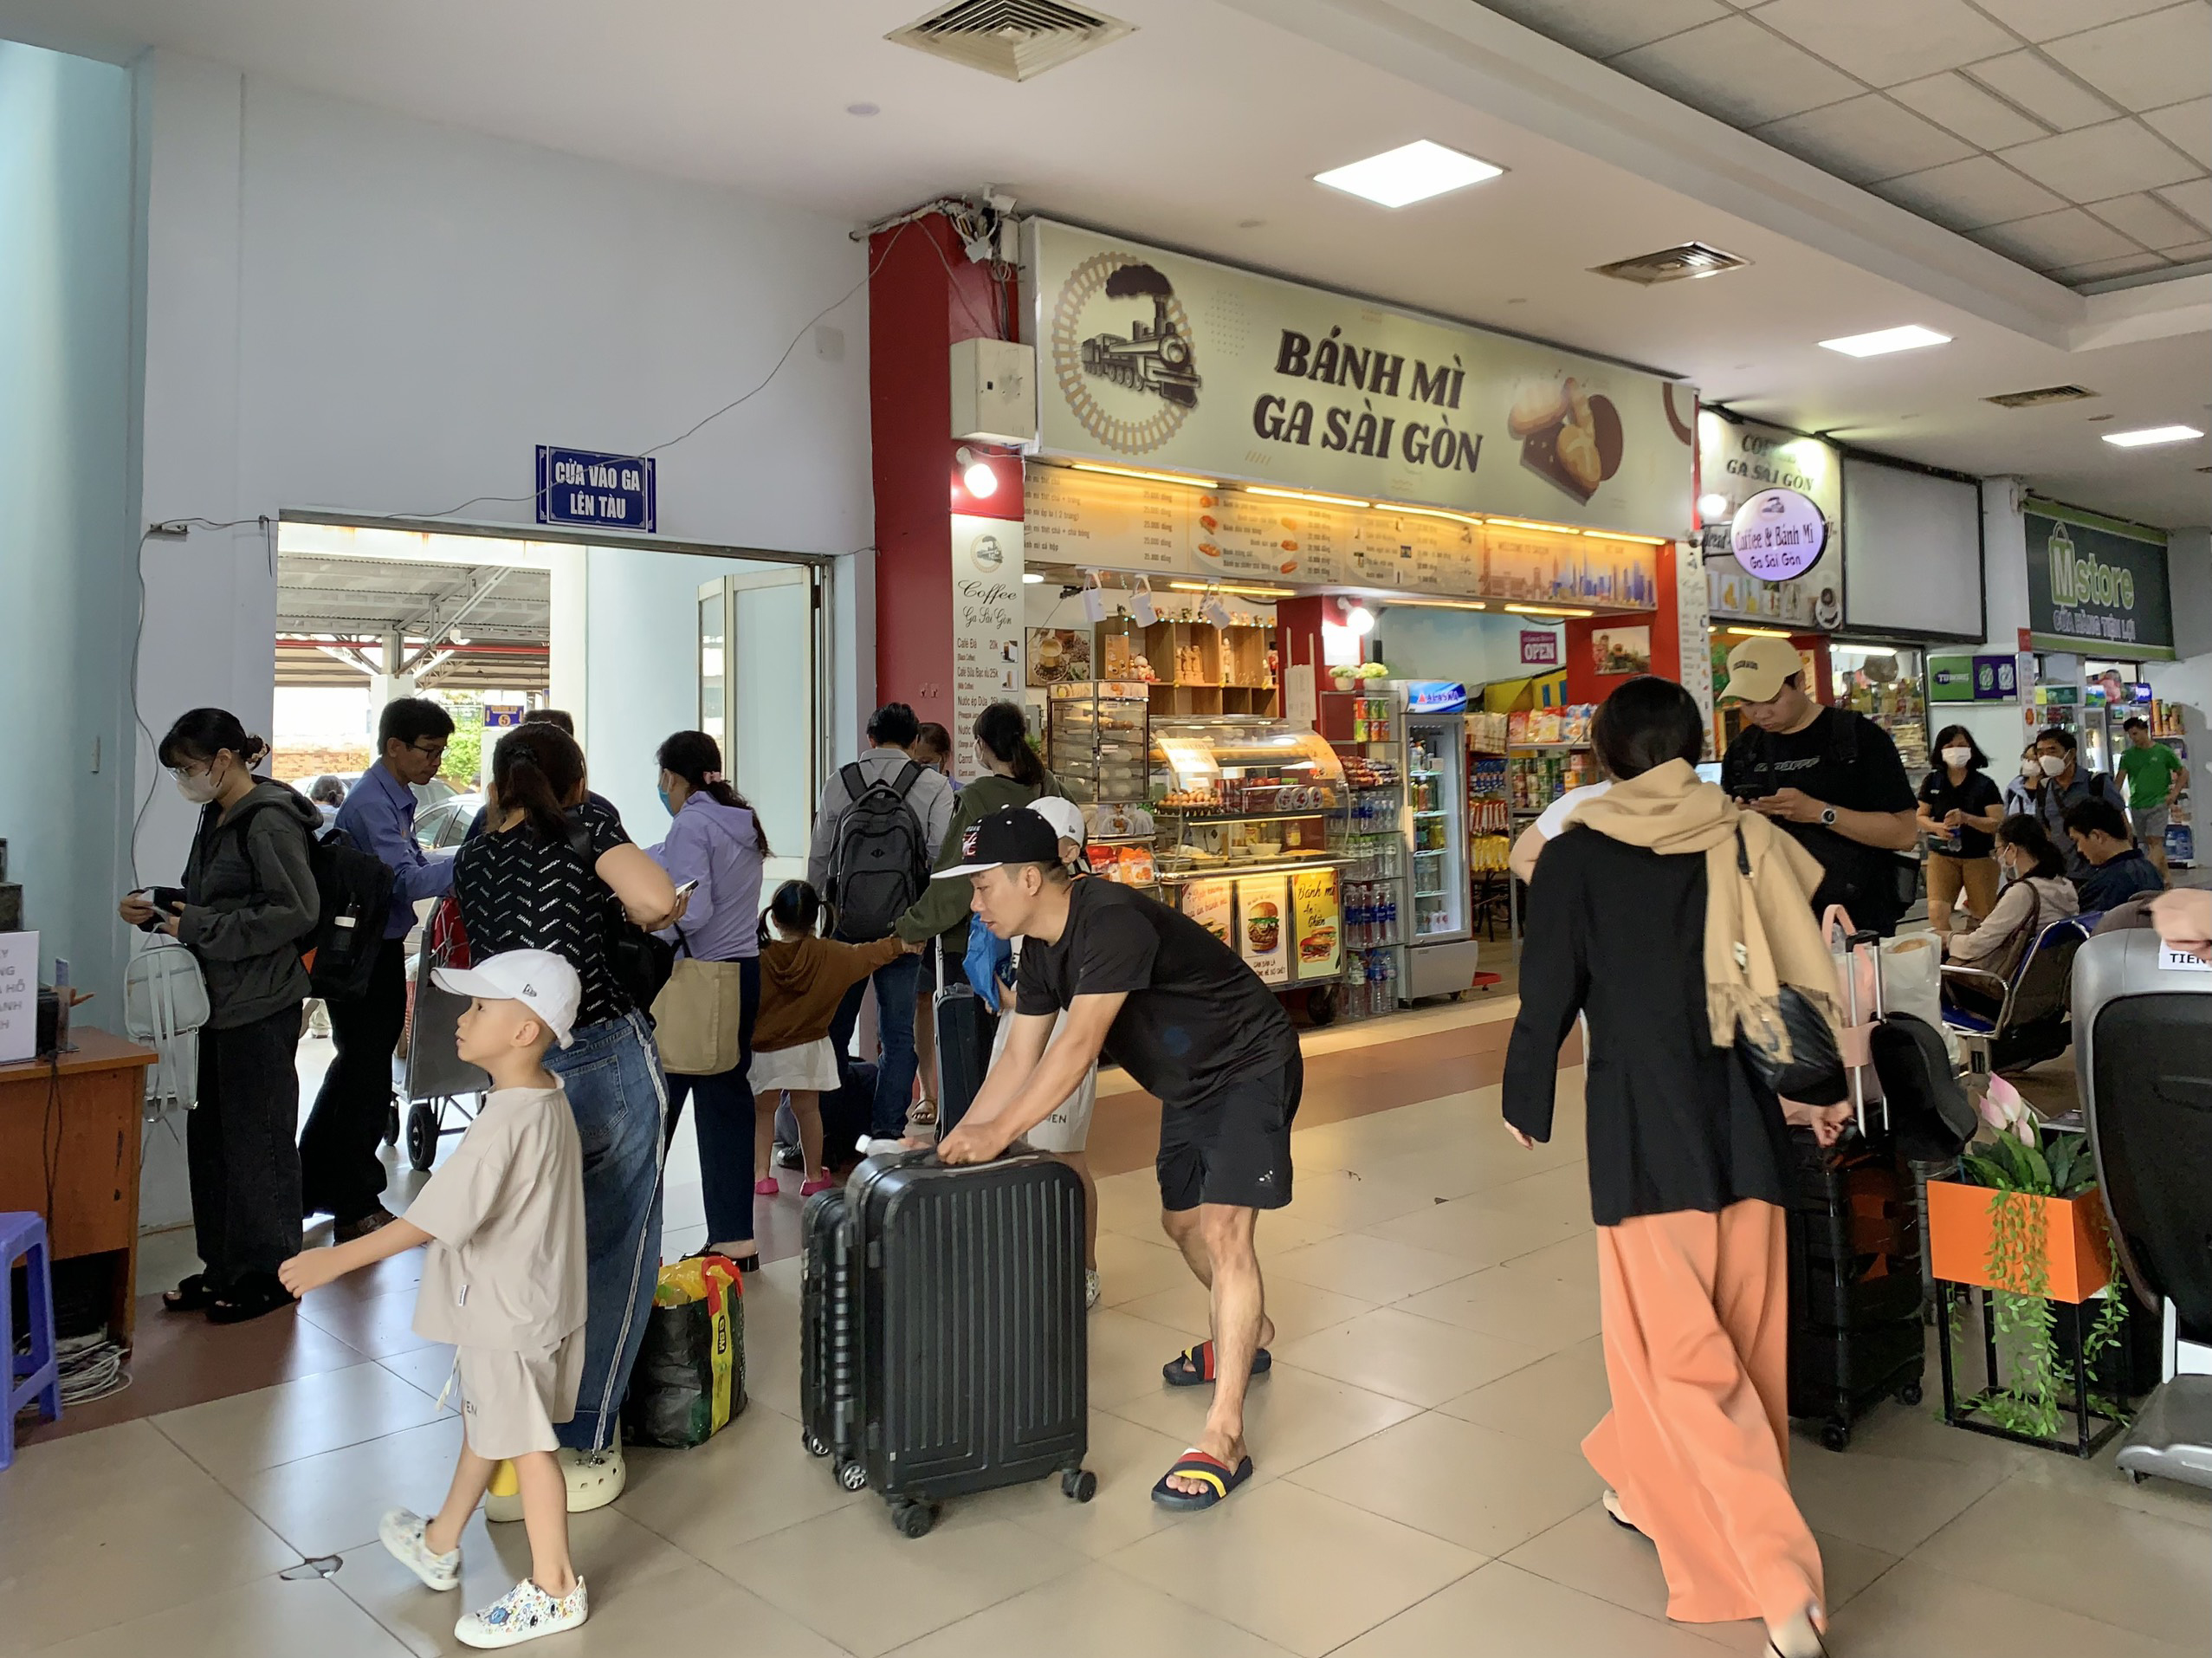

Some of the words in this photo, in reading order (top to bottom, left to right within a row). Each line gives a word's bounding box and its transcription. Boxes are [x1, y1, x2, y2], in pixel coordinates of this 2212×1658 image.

[1274, 324, 1405, 397] BÁNH
[1408, 353, 1465, 410] MÌ
[1253, 392, 1314, 446] GA
[1321, 397, 1396, 459] SÀI
[1401, 413, 1484, 473] GÒN
[555, 458, 585, 487] CỬA
[589, 464, 618, 489] VÀO
[621, 470, 640, 491] GA
[1727, 459, 1748, 476] GA
[570, 490, 594, 516] LÊN
[598, 493, 626, 519] TÀU
[1736, 529, 1762, 552] Coffee
[1764, 527, 1773, 547] &
[1775, 523, 1800, 547] Bánh
[1750, 556, 1763, 570] Ga
[2052, 545, 2135, 610] Mstore
[958, 580, 1018, 605] Coffee
[963, 606, 977, 628] Ga
[1524, 643, 1554, 660] OPEN
[1427, 690, 1458, 702] ALASKA
[1298, 880, 1321, 901] Bánh
